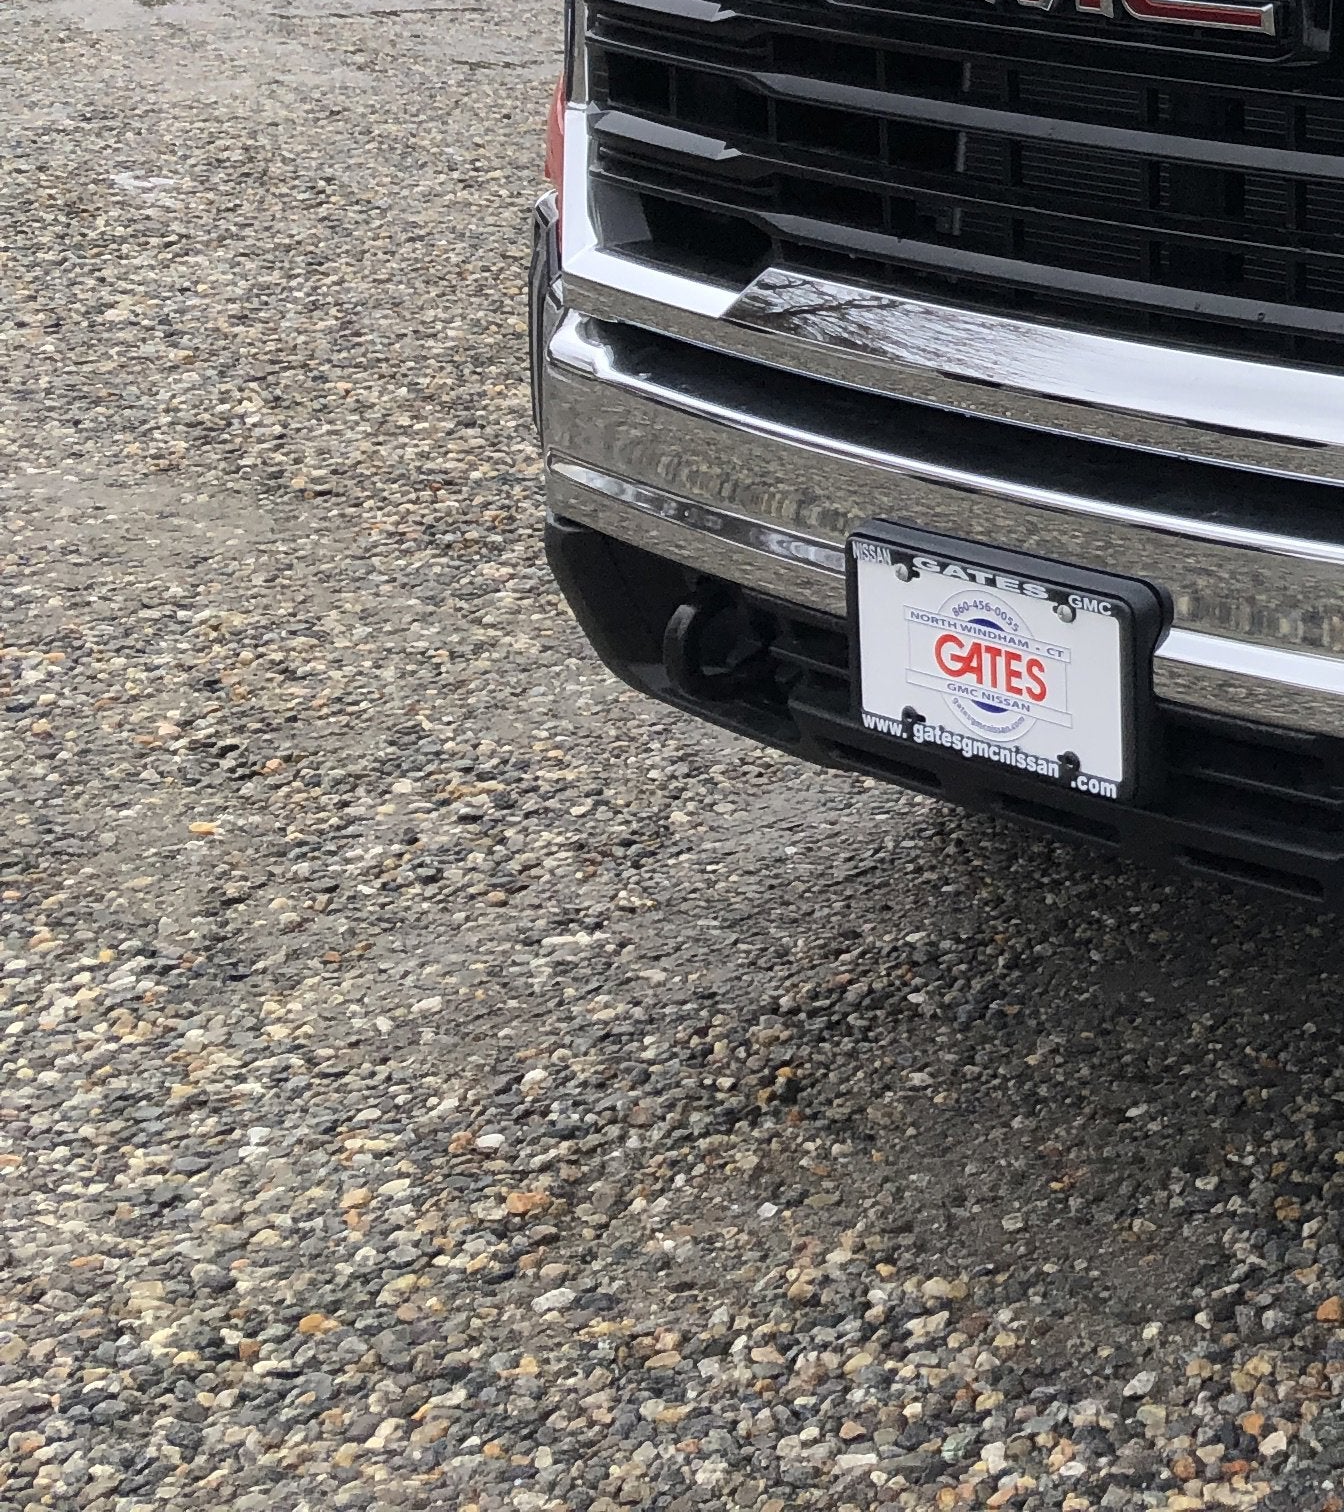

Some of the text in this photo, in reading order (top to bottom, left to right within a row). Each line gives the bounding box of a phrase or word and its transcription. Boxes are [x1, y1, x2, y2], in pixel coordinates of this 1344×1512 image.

[852, 541, 891, 566] NISSAN
[912, 556, 1049, 600] GATES
[952, 599, 1020, 633] 860-456-0055
[1067, 594, 1112, 616] GMC
[910, 611, 957, 630] NORTH
[960, 623, 1030, 649] WINDHAM
[1046, 647, 1065, 658] CT
[934, 633, 1047, 702] GATES
[946, 682, 1031, 713] GMC NISSAN
